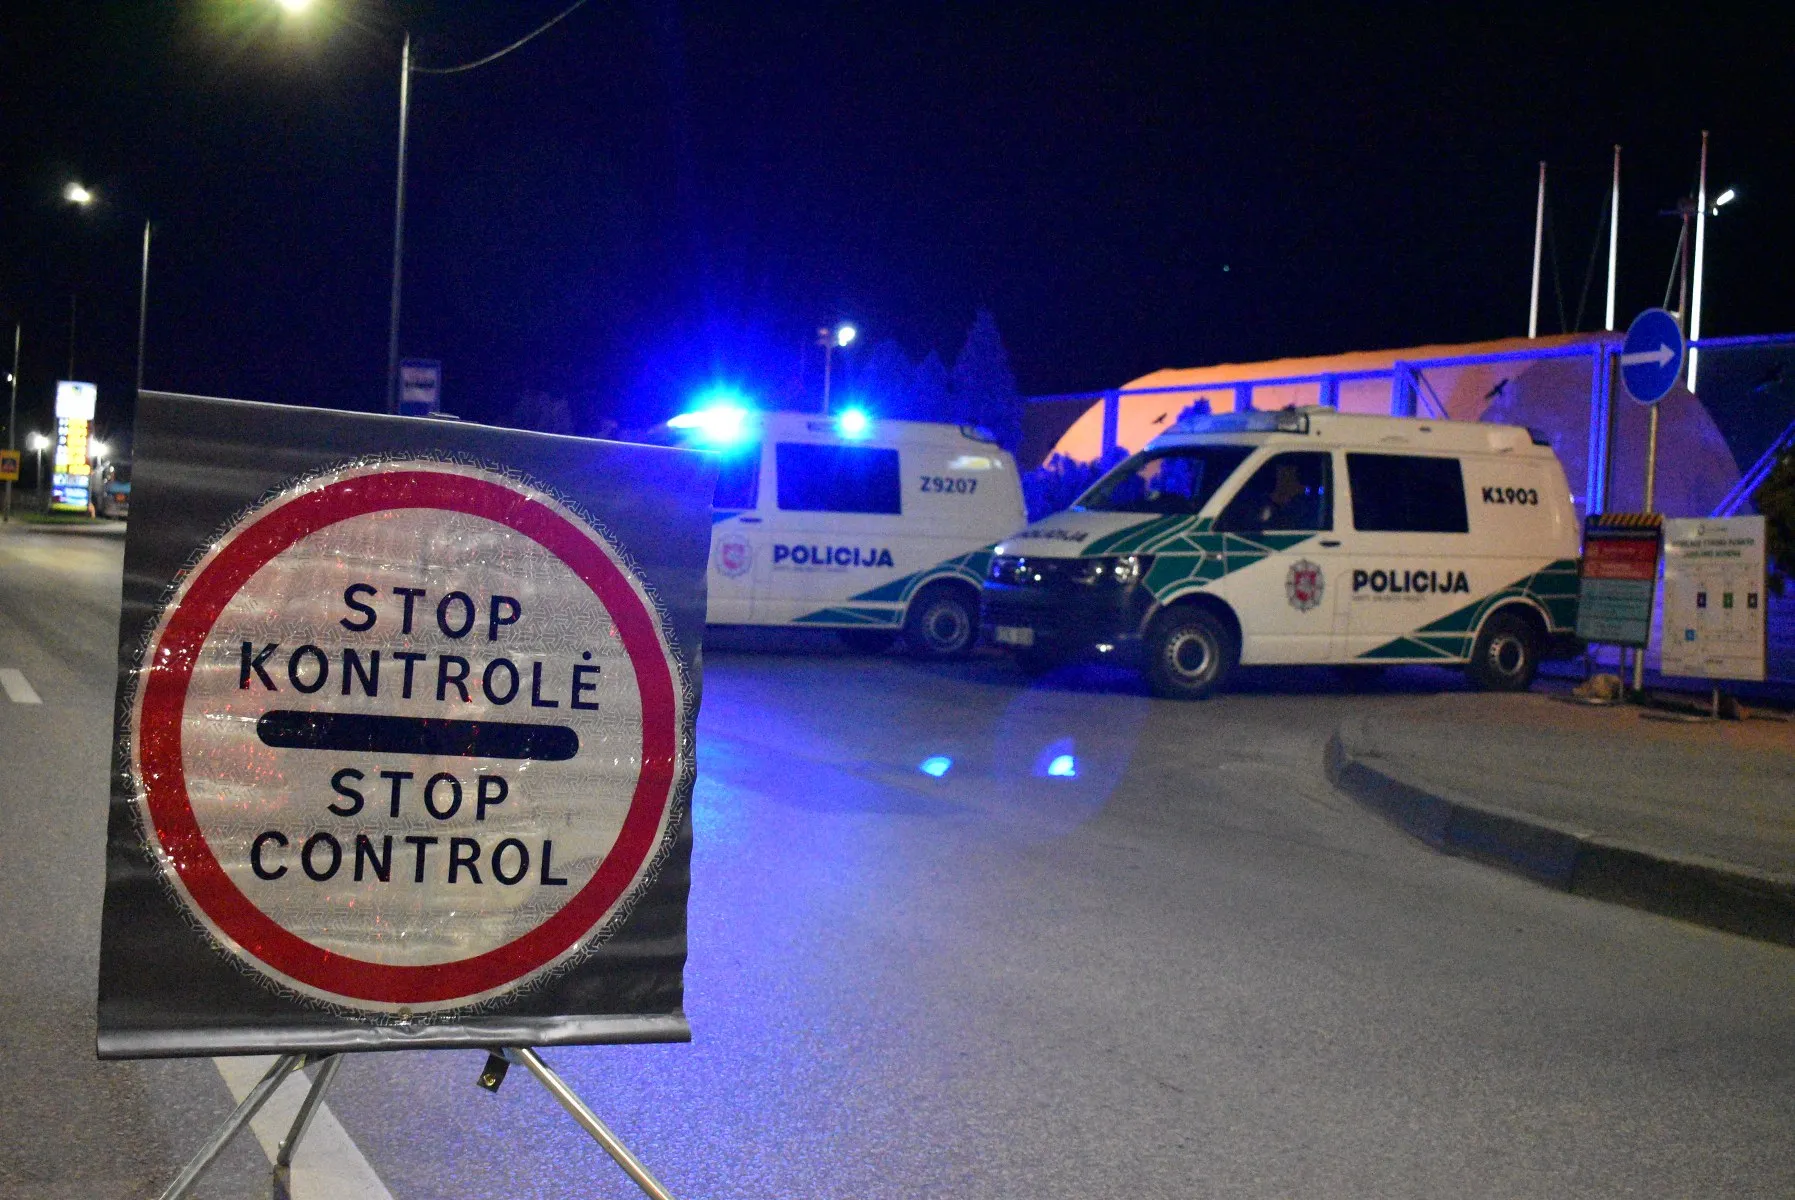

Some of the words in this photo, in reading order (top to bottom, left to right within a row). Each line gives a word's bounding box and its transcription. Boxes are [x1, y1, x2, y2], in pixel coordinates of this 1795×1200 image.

[920, 475, 978, 494] Z9207
[1482, 487, 1539, 505] K1903
[774, 544, 894, 568] POLICIJA
[1352, 569, 1470, 593] POLICIJA
[340, 582, 523, 641] STOP
[238, 641, 601, 710] KONTROLĖ
[327, 767, 509, 820] STOP
[251, 830, 568, 886] CONTROL
